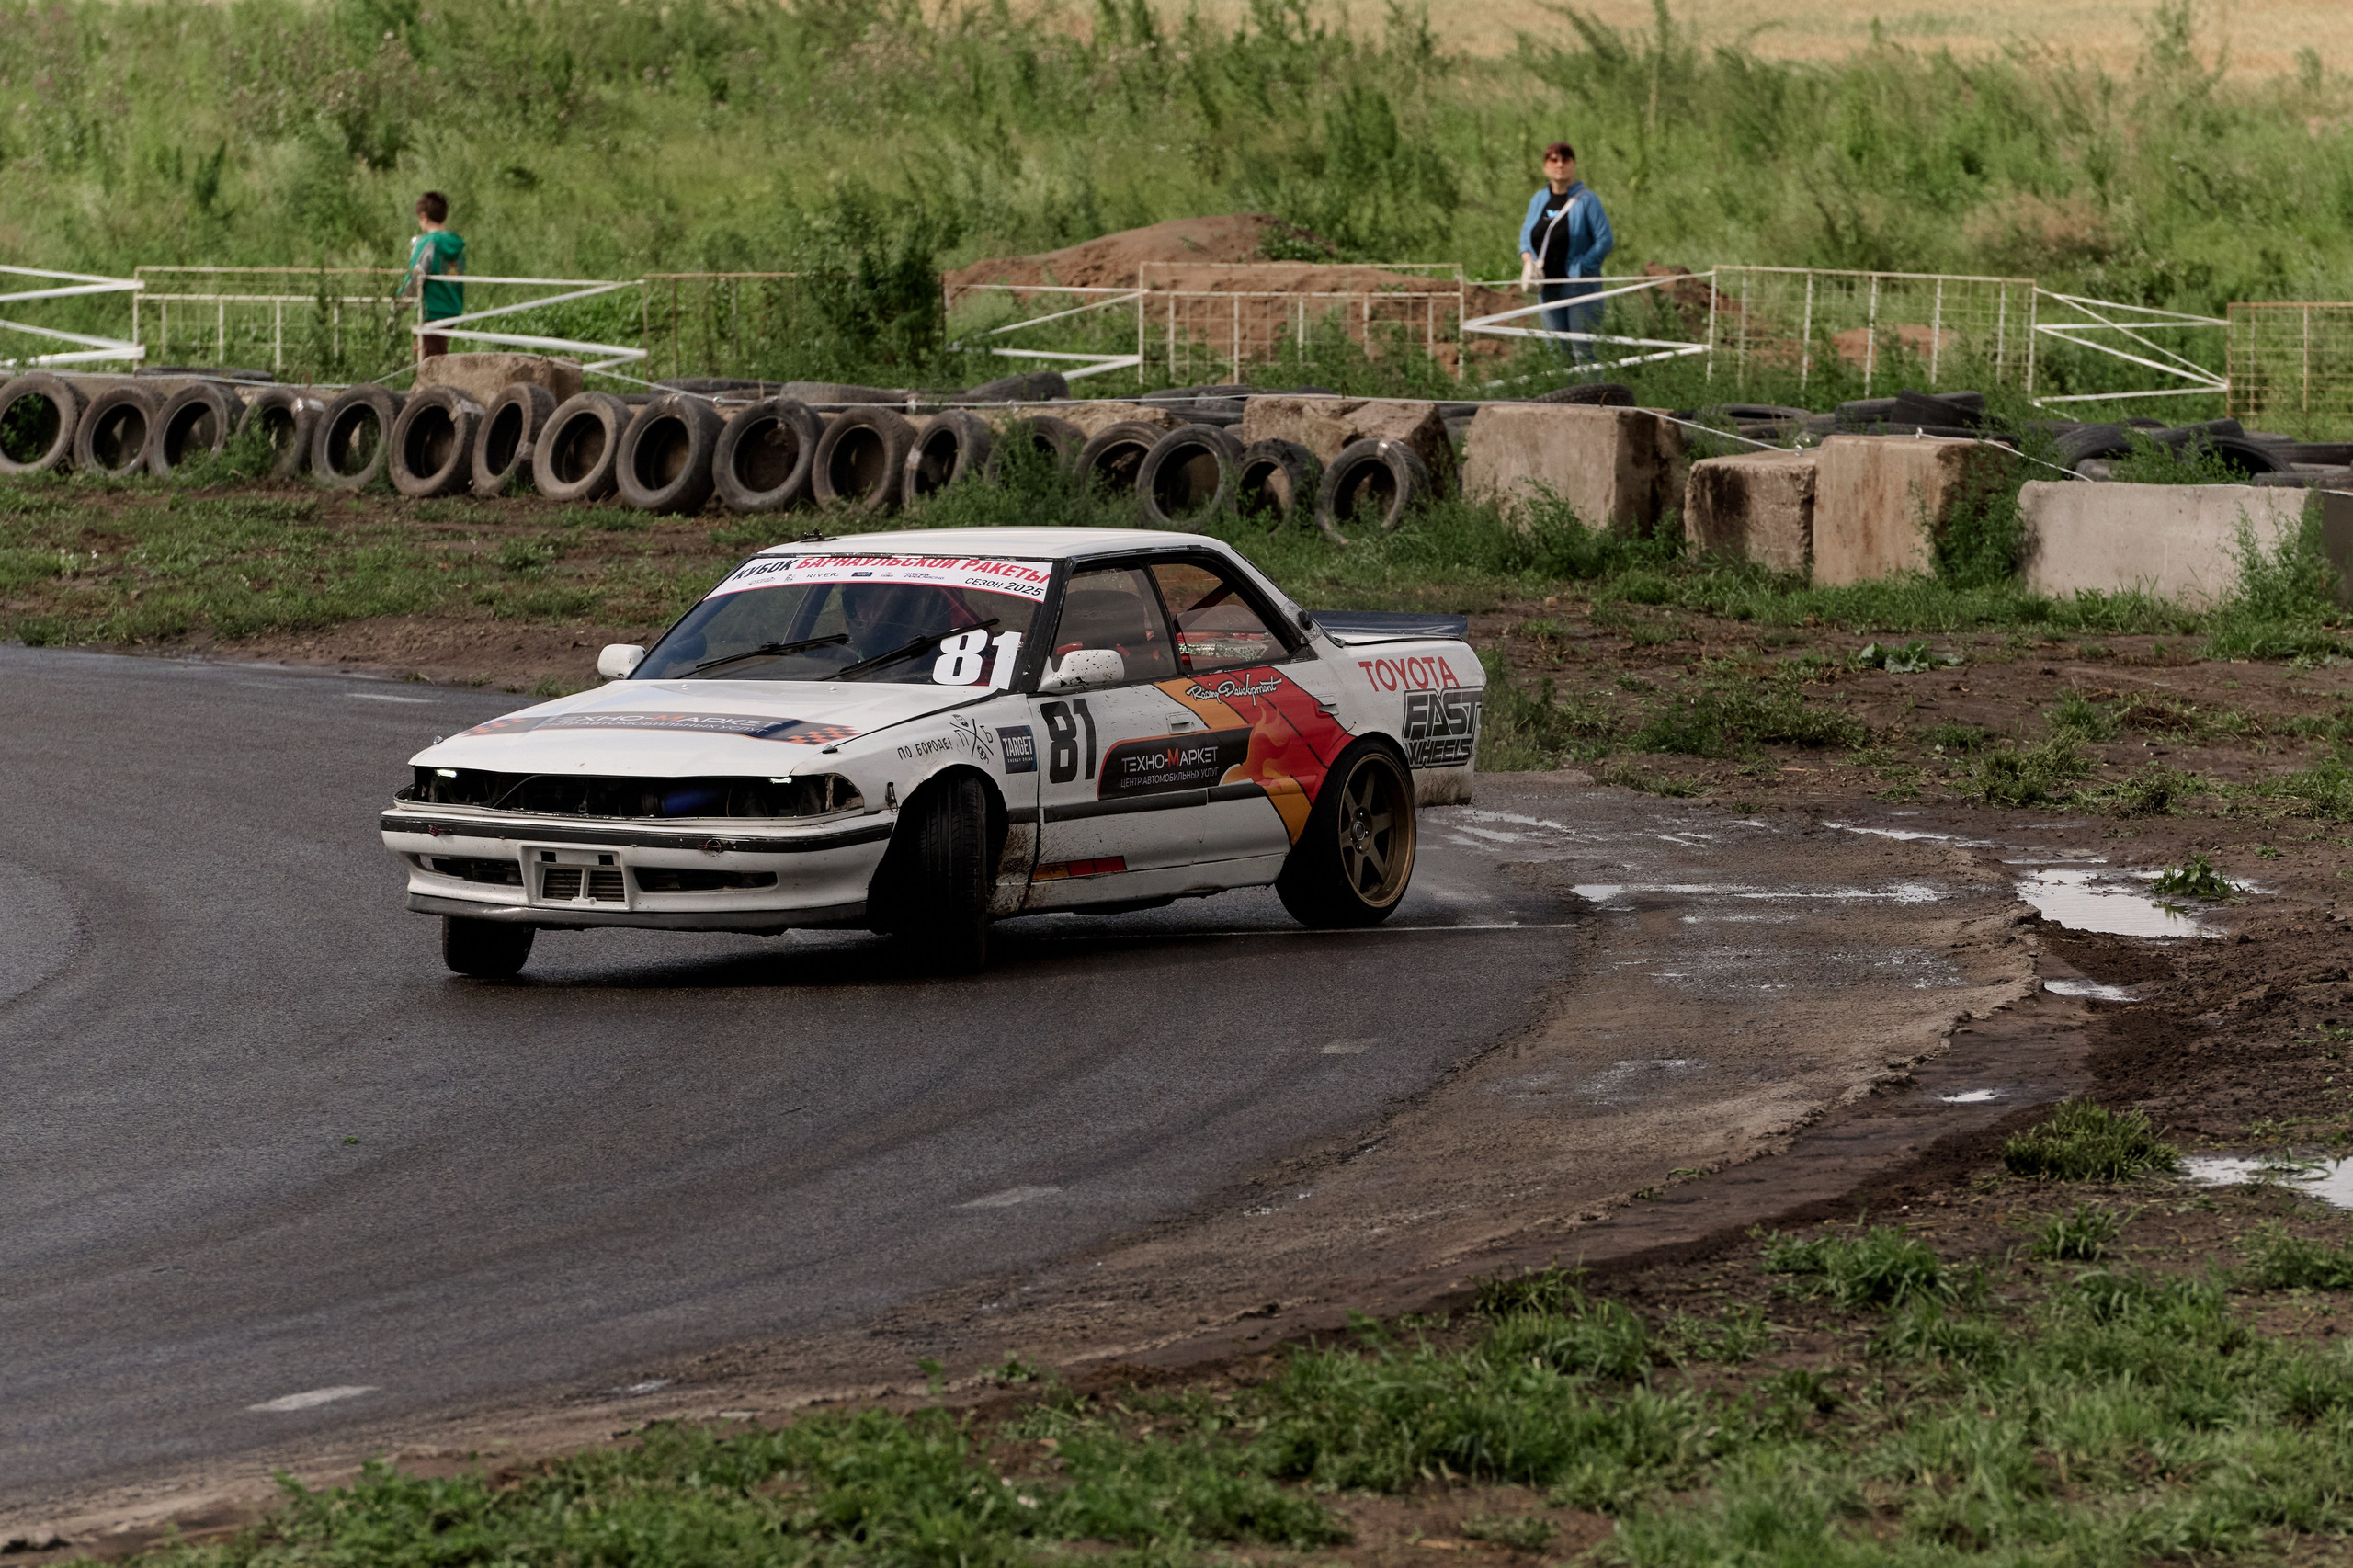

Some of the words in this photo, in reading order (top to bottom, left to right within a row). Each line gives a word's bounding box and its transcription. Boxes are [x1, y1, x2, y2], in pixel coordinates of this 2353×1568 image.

[732, 560, 798, 581] КУБОК
[960, 559, 1051, 585] РАКЕТЫ
[964, 577, 1004, 589] СЕЗОН
[1004, 582, 1045, 597] 2025
[932, 629, 1022, 690] 81
[1358, 656, 1461, 692] TOYOTA
[1185, 682, 1222, 703] Racing
[554, 713, 782, 728] ЕХНО-МАРКЕТ
[1404, 690, 1483, 739] FAST
[897, 746, 913, 761] ПО
[915, 737, 953, 756] БОРОДЕ!
[1002, 735, 1033, 756] TARGET
[1040, 698, 1097, 784] 81
[1404, 738, 1472, 765] WHEELS
[1121, 746, 1219, 773] ТЕХНО-МАРКЕТ
[1120, 777, 1142, 789] ЦЕНТР
[1142, 769, 1201, 786] АВТОМОБИЛЬНЫХ
[1200, 767, 1220, 778] УСЛУГ
